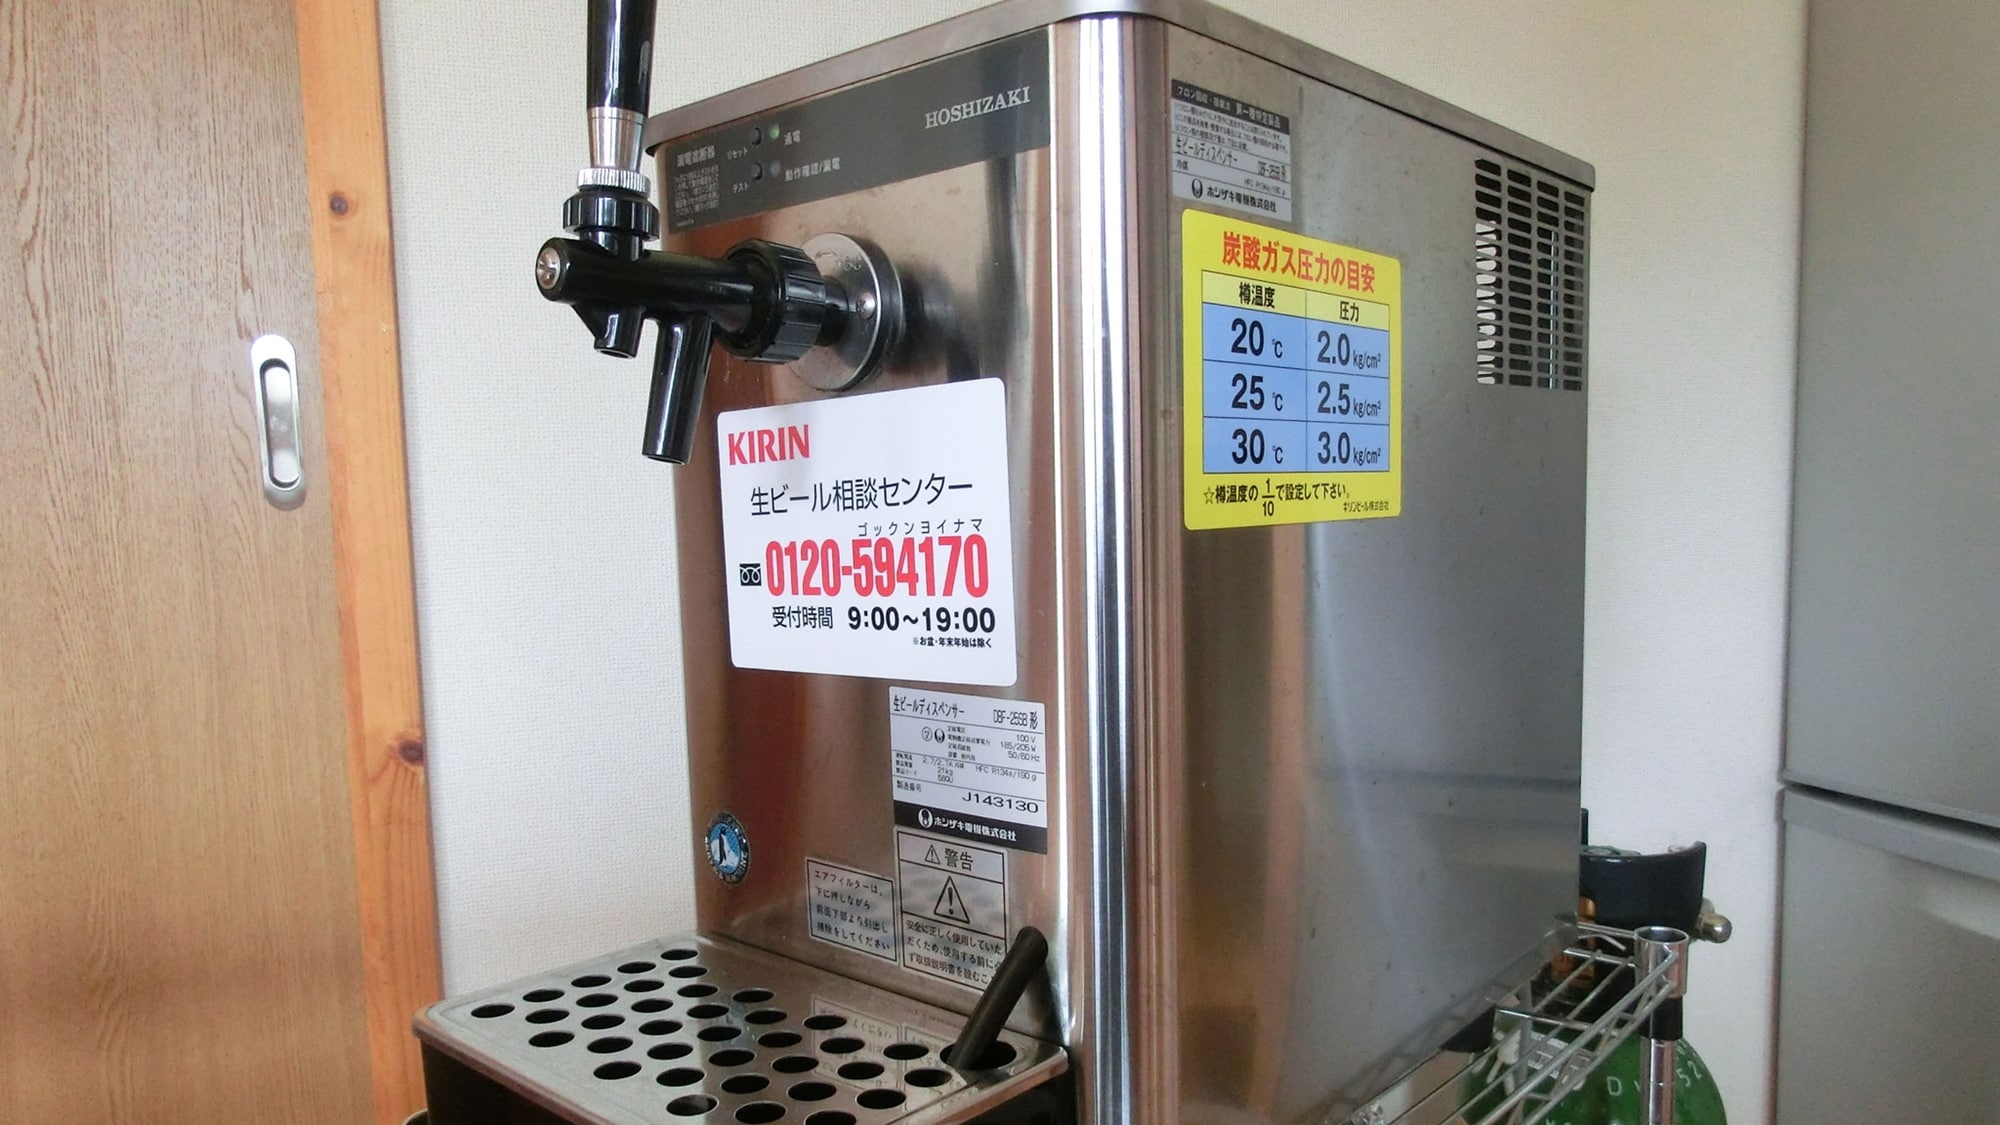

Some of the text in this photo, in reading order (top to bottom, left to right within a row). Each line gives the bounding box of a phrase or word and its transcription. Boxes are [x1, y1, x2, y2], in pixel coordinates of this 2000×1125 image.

[924, 86, 1031, 129] HOSHIZAKI
[732, 183, 750, 194] テスト
[1222, 230, 1376, 293] 炭酸ガス圧力の目安
[1239, 282, 1276, 309] 樽温度
[1339, 301, 1360, 323] 圧力
[1231, 318, 1265, 357] 20
[1316, 330, 1351, 366] 2.0
[1231, 373, 1265, 411] 25
[1317, 381, 1351, 416] 2.5
[727, 424, 810, 465] KIRIN
[1231, 428, 1265, 464] 30
[1317, 431, 1351, 465] 3.0
[750, 472, 973, 516] 生ビール相談センター
[857, 518, 984, 538] ゴックンヨイナマ
[765, 533, 990, 599] 0120-594170
[772, 605, 834, 630] 受付時間
[893, 694, 965, 719] 生ビールディスペンサー
[962, 790, 1039, 814] J143130
[934, 816, 1017, 842] ホシザキ電機株式会社
[944, 847, 973, 871] 警告
[815, 870, 883, 897] エアフィルターは、
[815, 886, 871, 910] 下に押しながら
[816, 903, 888, 934] 前面下部より引出し
[817, 921, 890, 950] 掃除をしてください
[906, 919, 1002, 955] 安全に正しく使用していた
[907, 952, 994, 985] ず取扱説明書を読むこ
